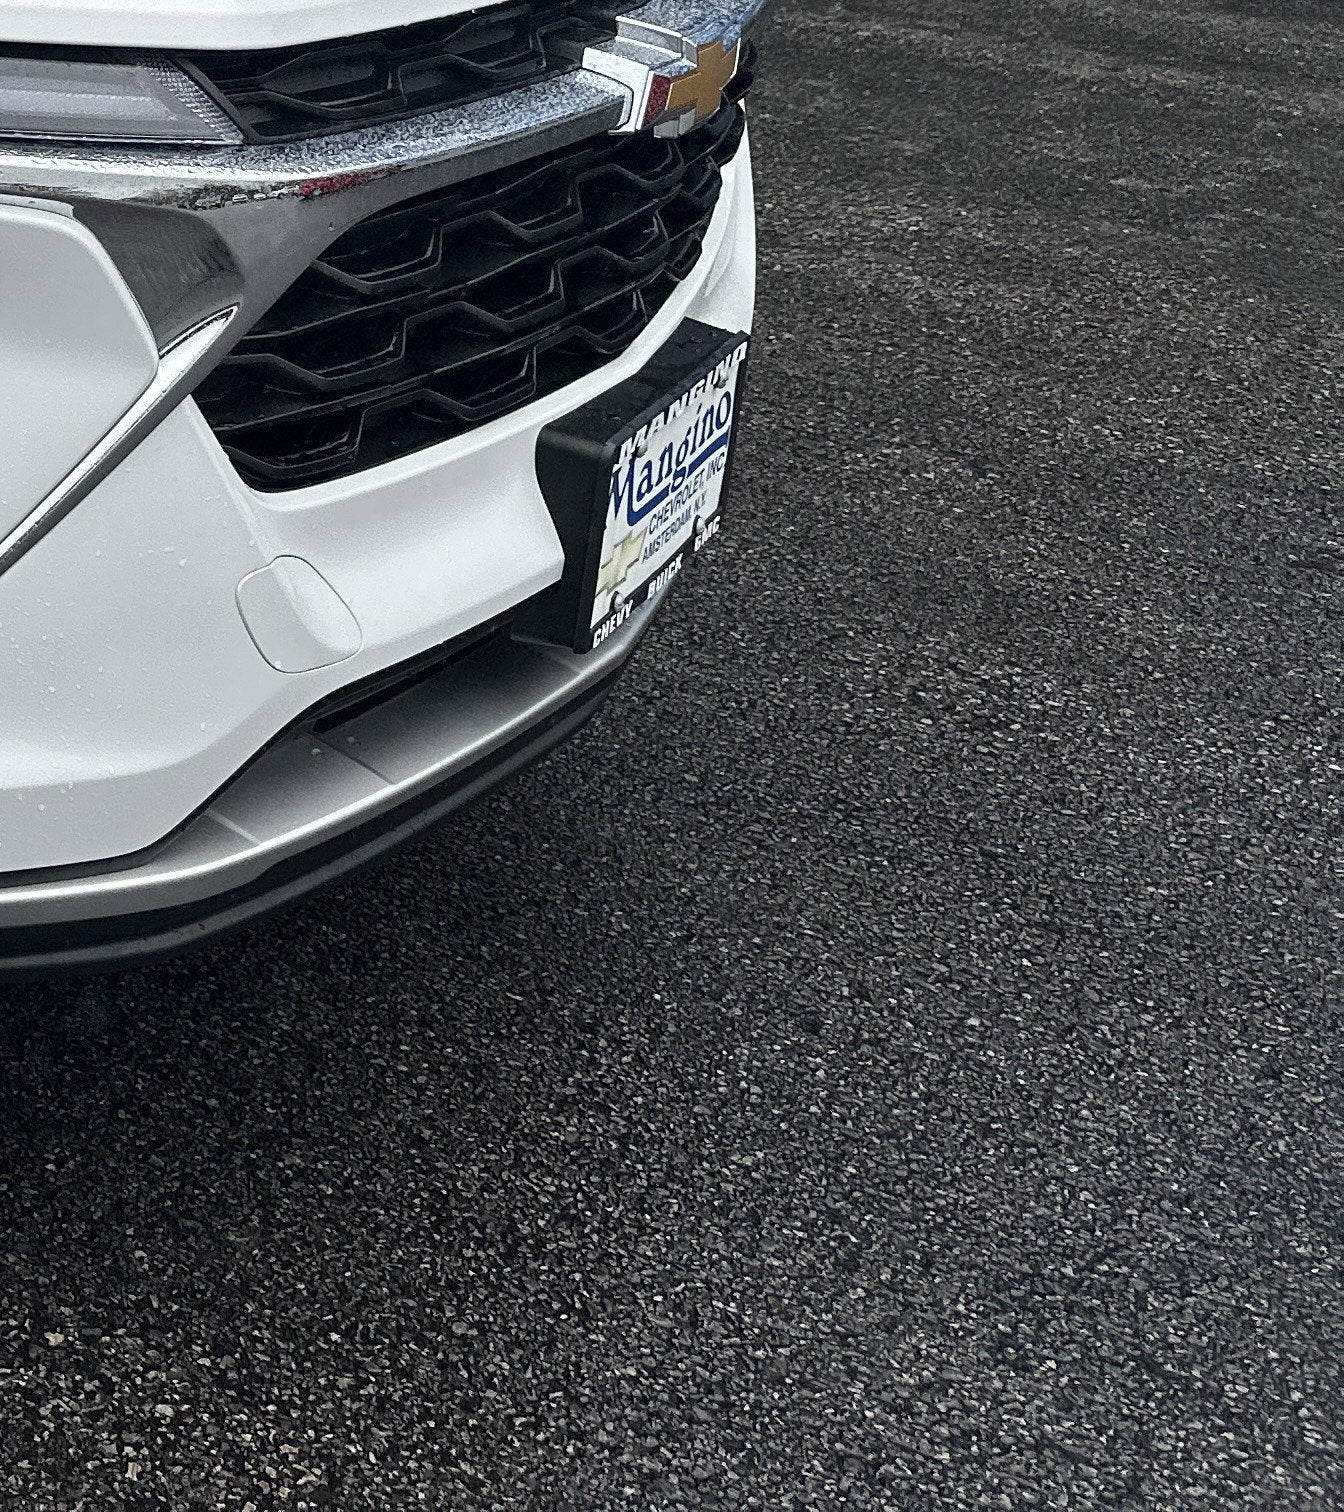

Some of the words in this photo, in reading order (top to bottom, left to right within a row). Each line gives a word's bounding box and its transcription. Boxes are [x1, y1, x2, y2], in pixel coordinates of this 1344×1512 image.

[610, 390, 732, 525] Mangino
[618, 341, 748, 465] MANGINO
[592, 599, 633, 649] CHEVY
[647, 553, 683, 601] BUICK
[694, 515, 721, 552] GMC
